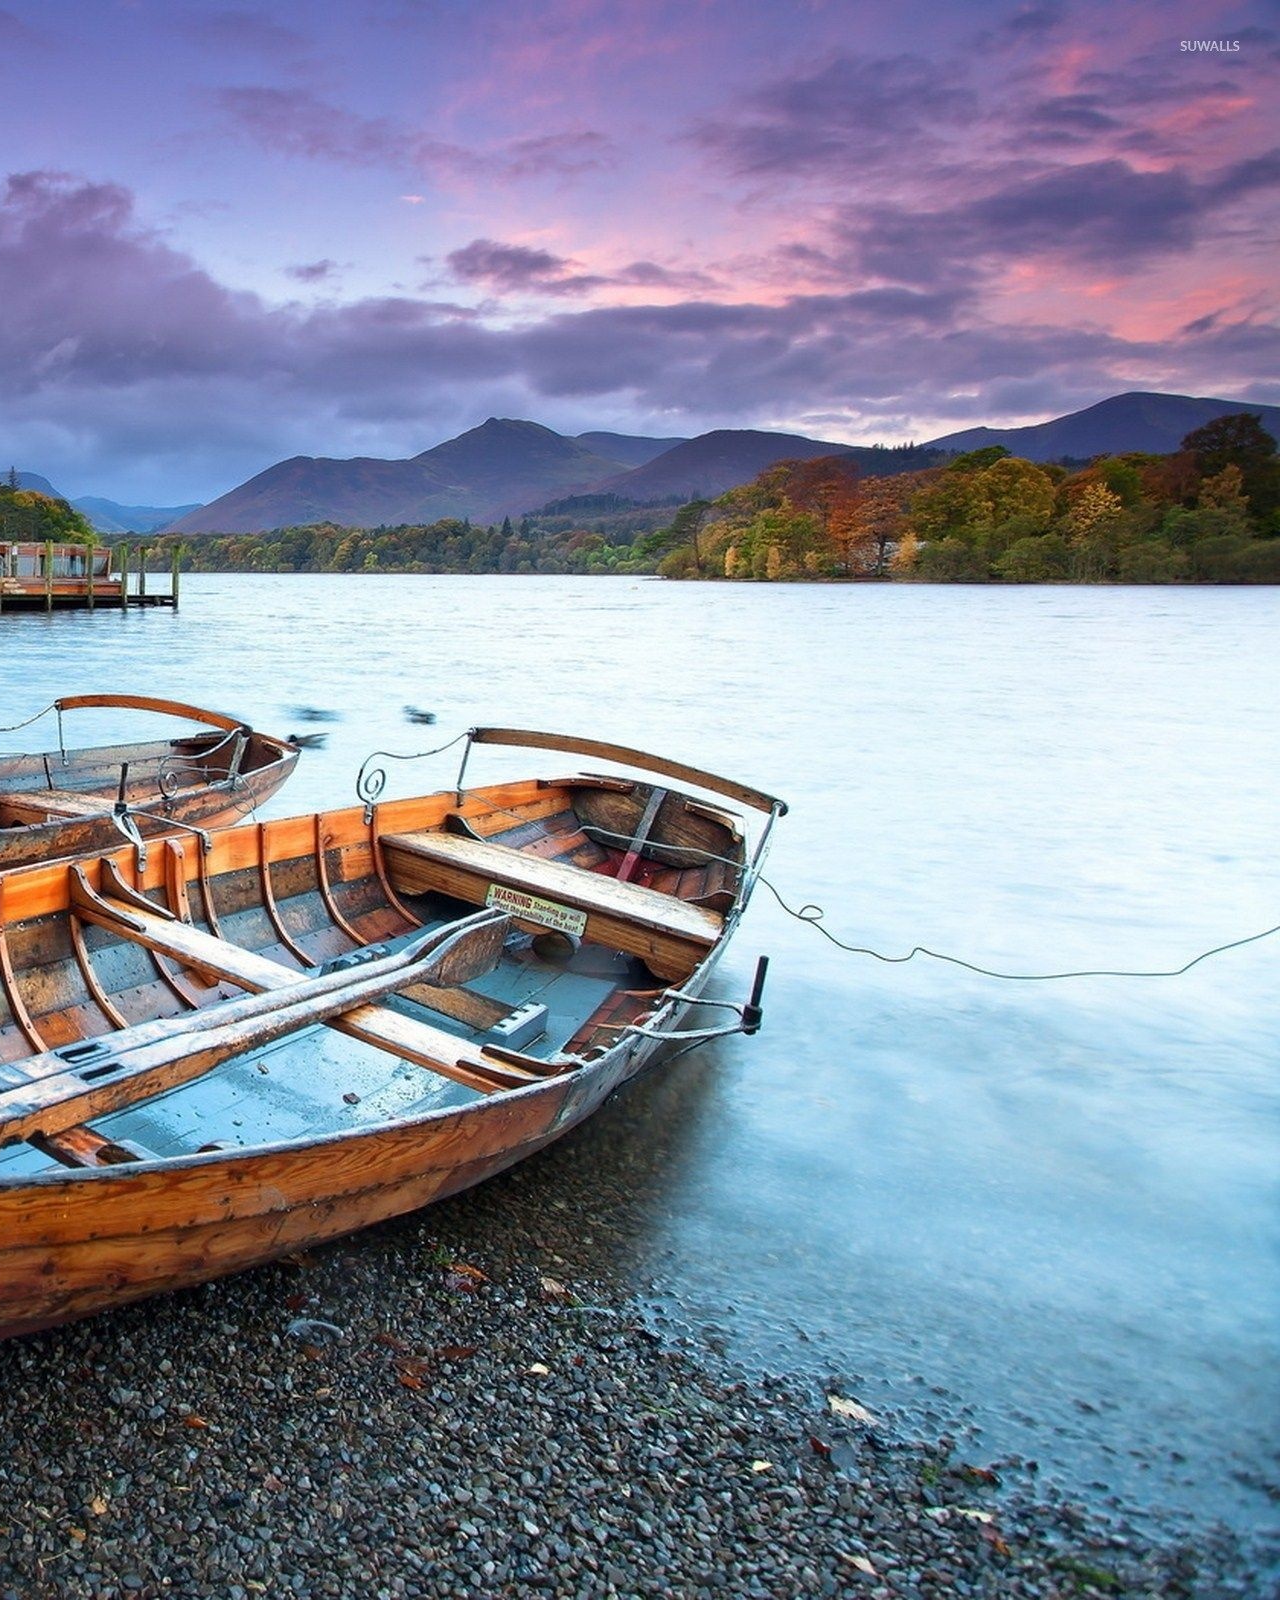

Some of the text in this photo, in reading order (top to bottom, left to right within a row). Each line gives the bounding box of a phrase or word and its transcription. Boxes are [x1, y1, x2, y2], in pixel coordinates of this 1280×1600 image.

[494, 887, 533, 909] WARNING
[533, 901, 560, 917] Standing
[552, 917, 563, 927] the
